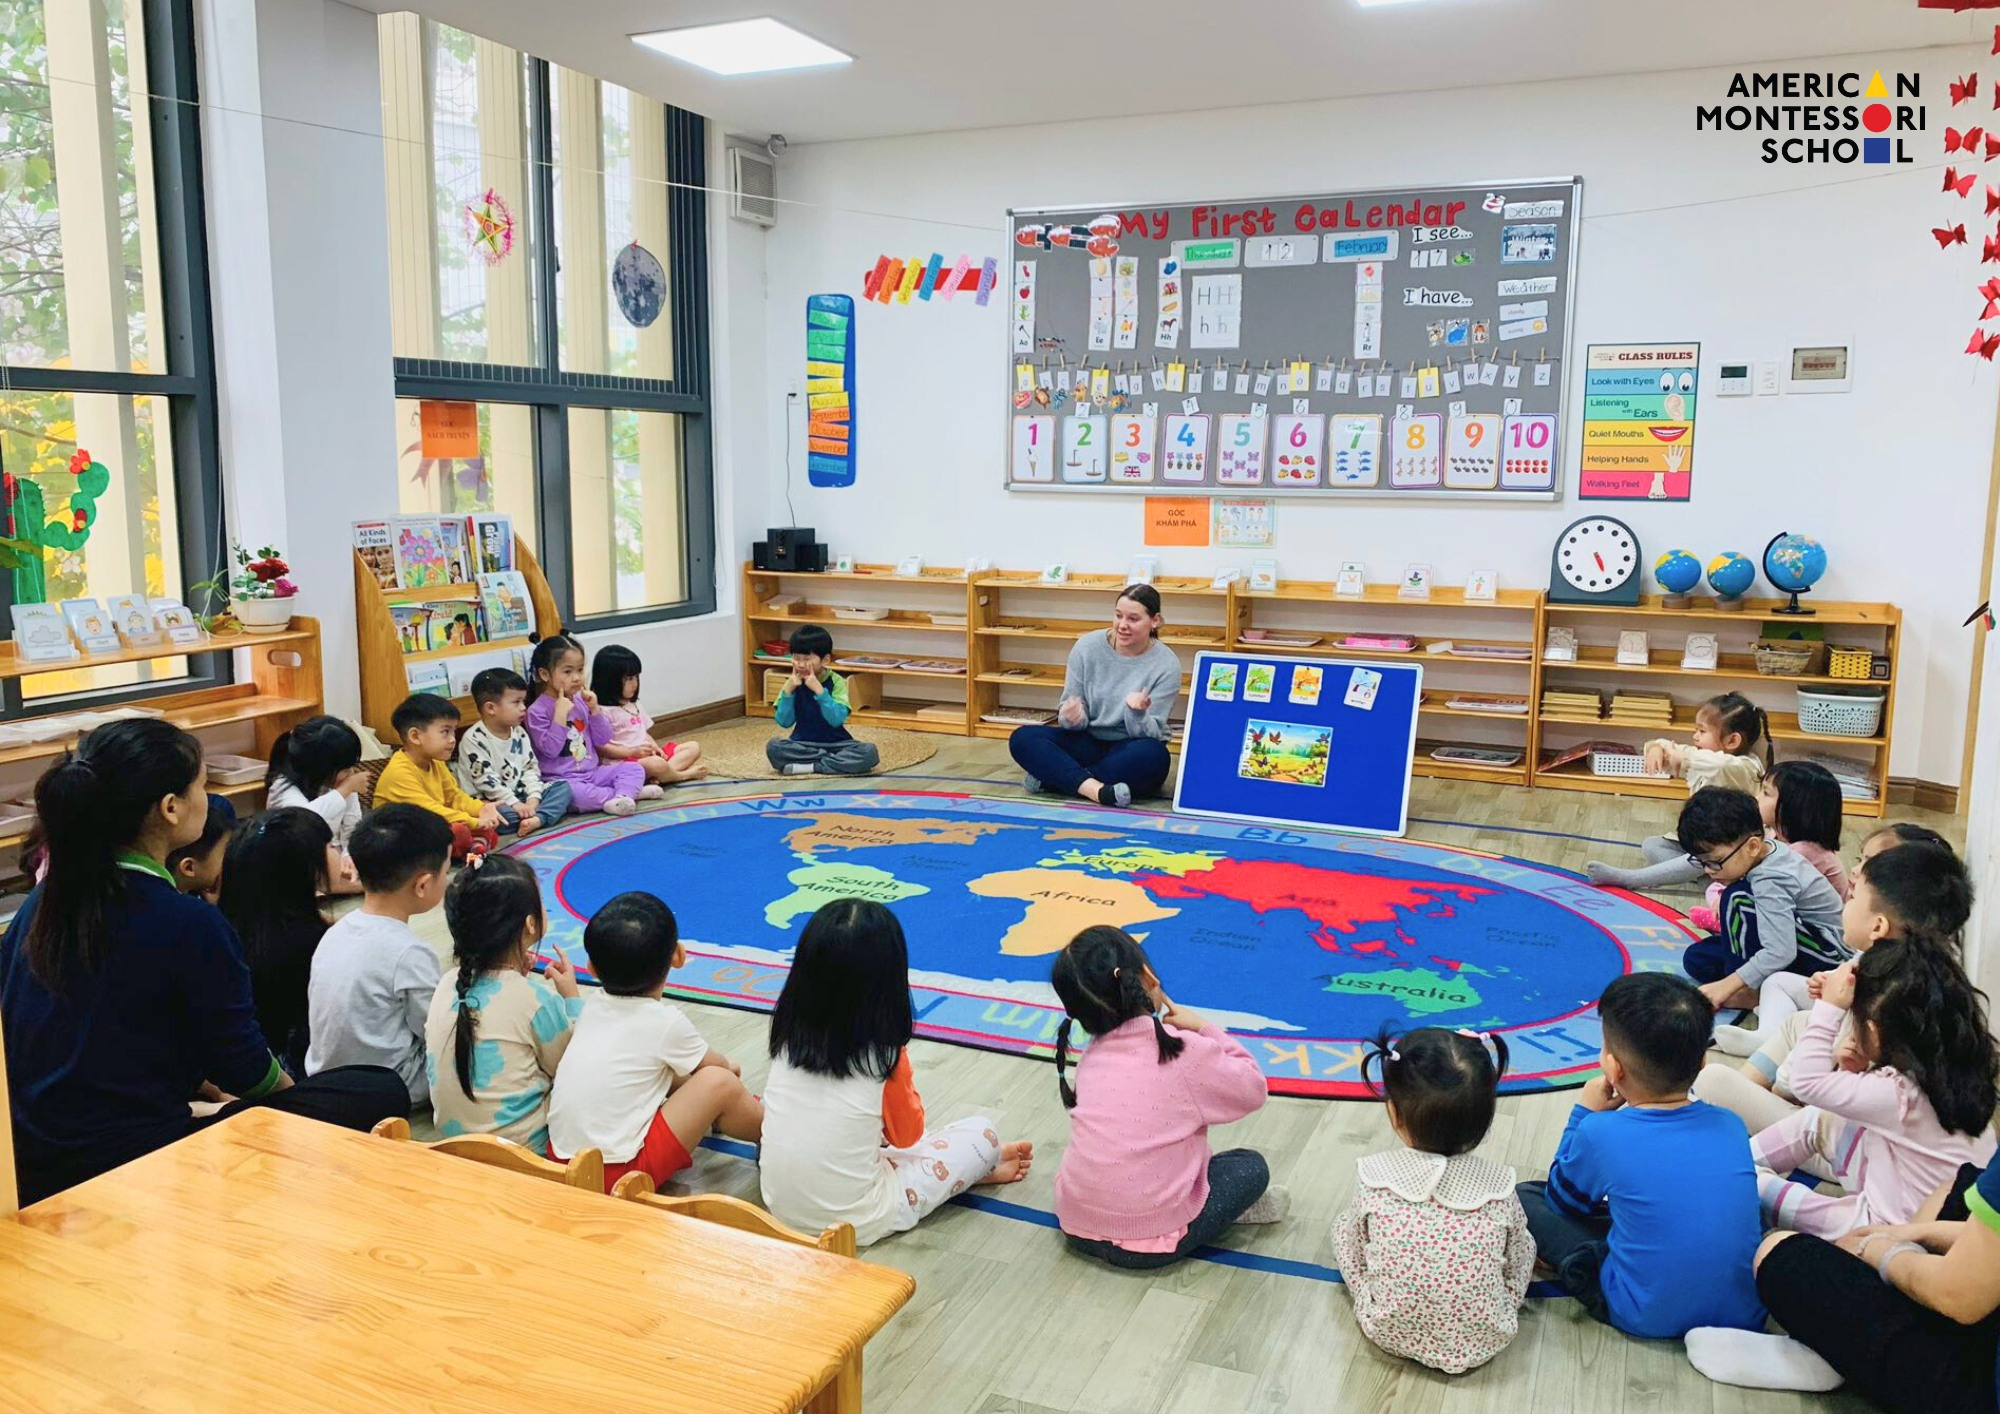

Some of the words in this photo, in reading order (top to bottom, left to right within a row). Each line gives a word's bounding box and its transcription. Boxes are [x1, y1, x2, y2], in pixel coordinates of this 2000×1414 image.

[1115, 210, 1169, 240] My
[1192, 206, 1278, 238] First
[1414, 227, 1422, 243] I
[1618, 352, 1653, 361] CLASS
[1656, 351, 1693, 360] RULES
[1591, 377, 1612, 386] Look
[1614, 377, 1632, 386] with
[1633, 377, 1654, 387] Eyes
[1590, 399, 1629, 408] Listening
[1633, 409, 1658, 418] Ears
[1028, 423, 1038, 446] 1
[1077, 422, 1092, 446] 2
[1125, 423, 1141, 447] 3
[1177, 423, 1196, 447] 4
[1234, 422, 1251, 447] 5
[1289, 422, 1307, 448] 6
[1347, 424, 1365, 449] 7
[1406, 424, 1426, 450] 8
[1465, 422, 1484, 449] 9
[1510, 422, 1550, 449] 10
[1588, 430, 1611, 438] Quiet
[1612, 430, 1645, 438] Mouths
[1587, 455, 1619, 465] Helping
[1621, 455, 1649, 464] Hands
[1586, 480, 1620, 489] Walking
[804, 830, 895, 846] America
[829, 823, 896, 838] North
[1236, 827, 1308, 845] Bb
[1083, 855, 1169, 872] Europe
[800, 882, 900, 902] America
[826, 875, 900, 892] South
[1030, 889, 1117, 907] Africa
[1312, 973, 1468, 1004] Australia
